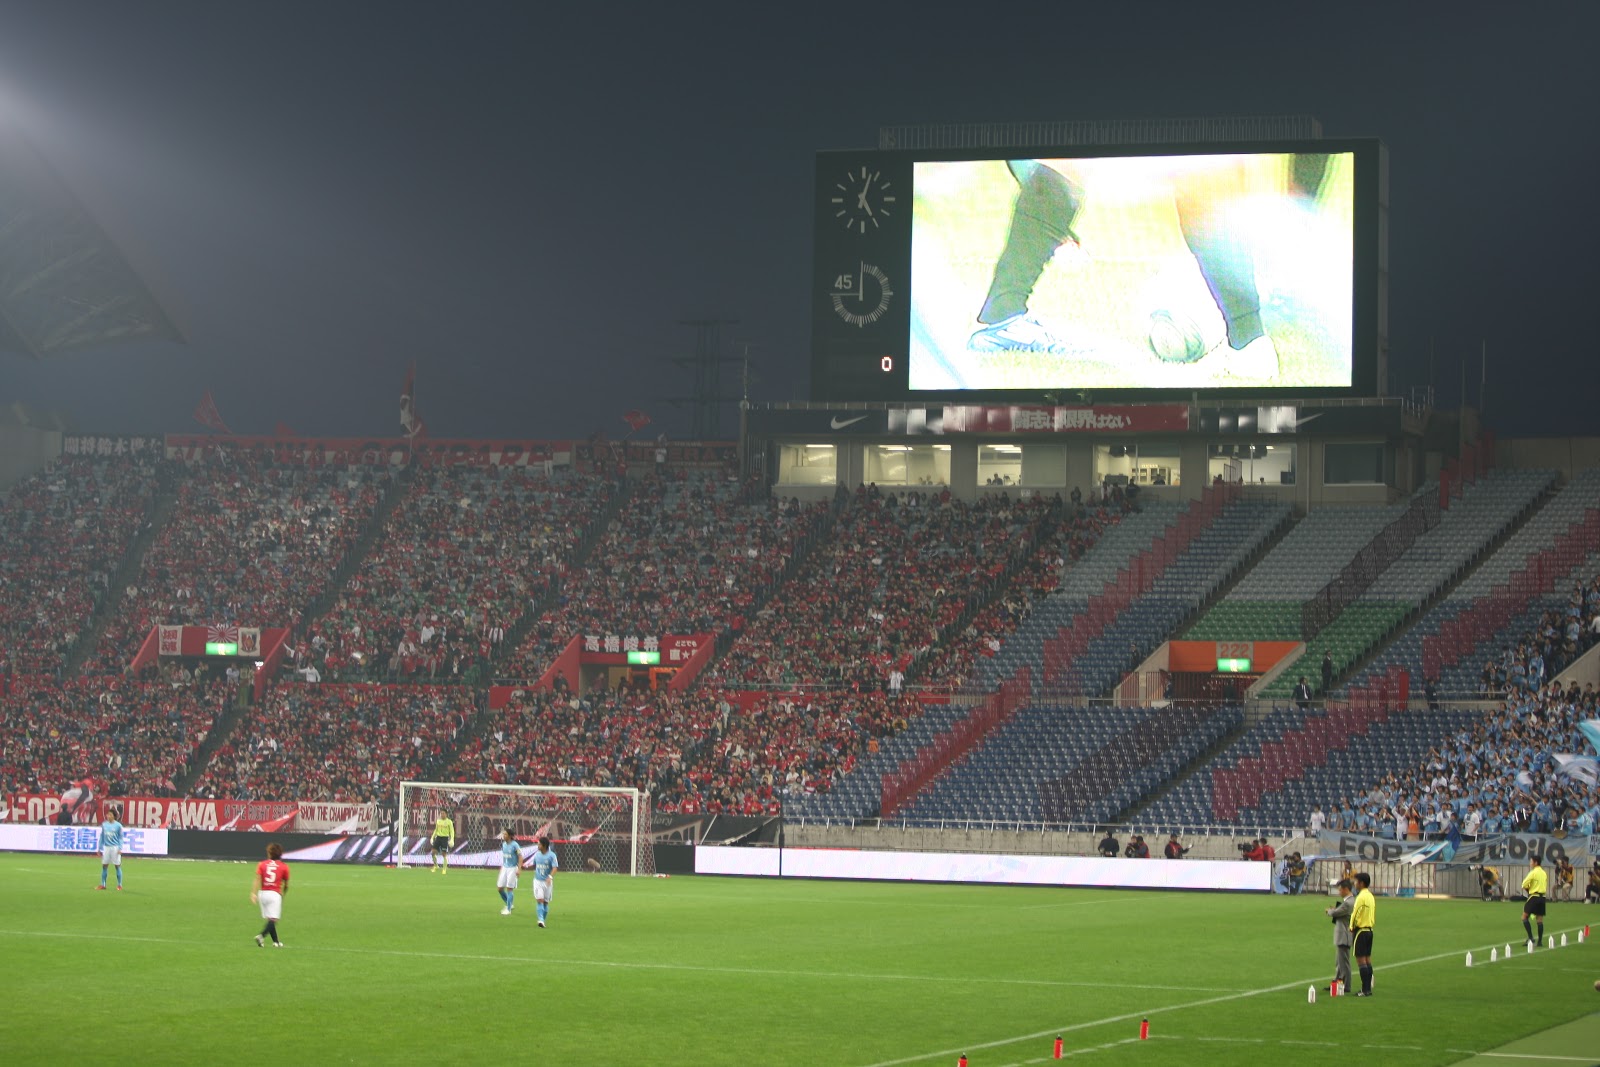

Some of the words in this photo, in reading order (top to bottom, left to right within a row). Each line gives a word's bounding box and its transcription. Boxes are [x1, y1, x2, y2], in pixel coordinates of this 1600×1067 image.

[833, 275, 852, 289] 45
[881, 356, 892, 372] 0
[1220, 643, 1249, 657] 222
[128, 799, 219, 831] URAWA
[232, 805, 246, 820] THE
[300, 806, 315, 821] SHOW
[317, 806, 328, 821] THE
[412, 809, 427, 825] THE
[53, 827, 145, 853] 藤島宅
[265, 866, 278, 883] 5
